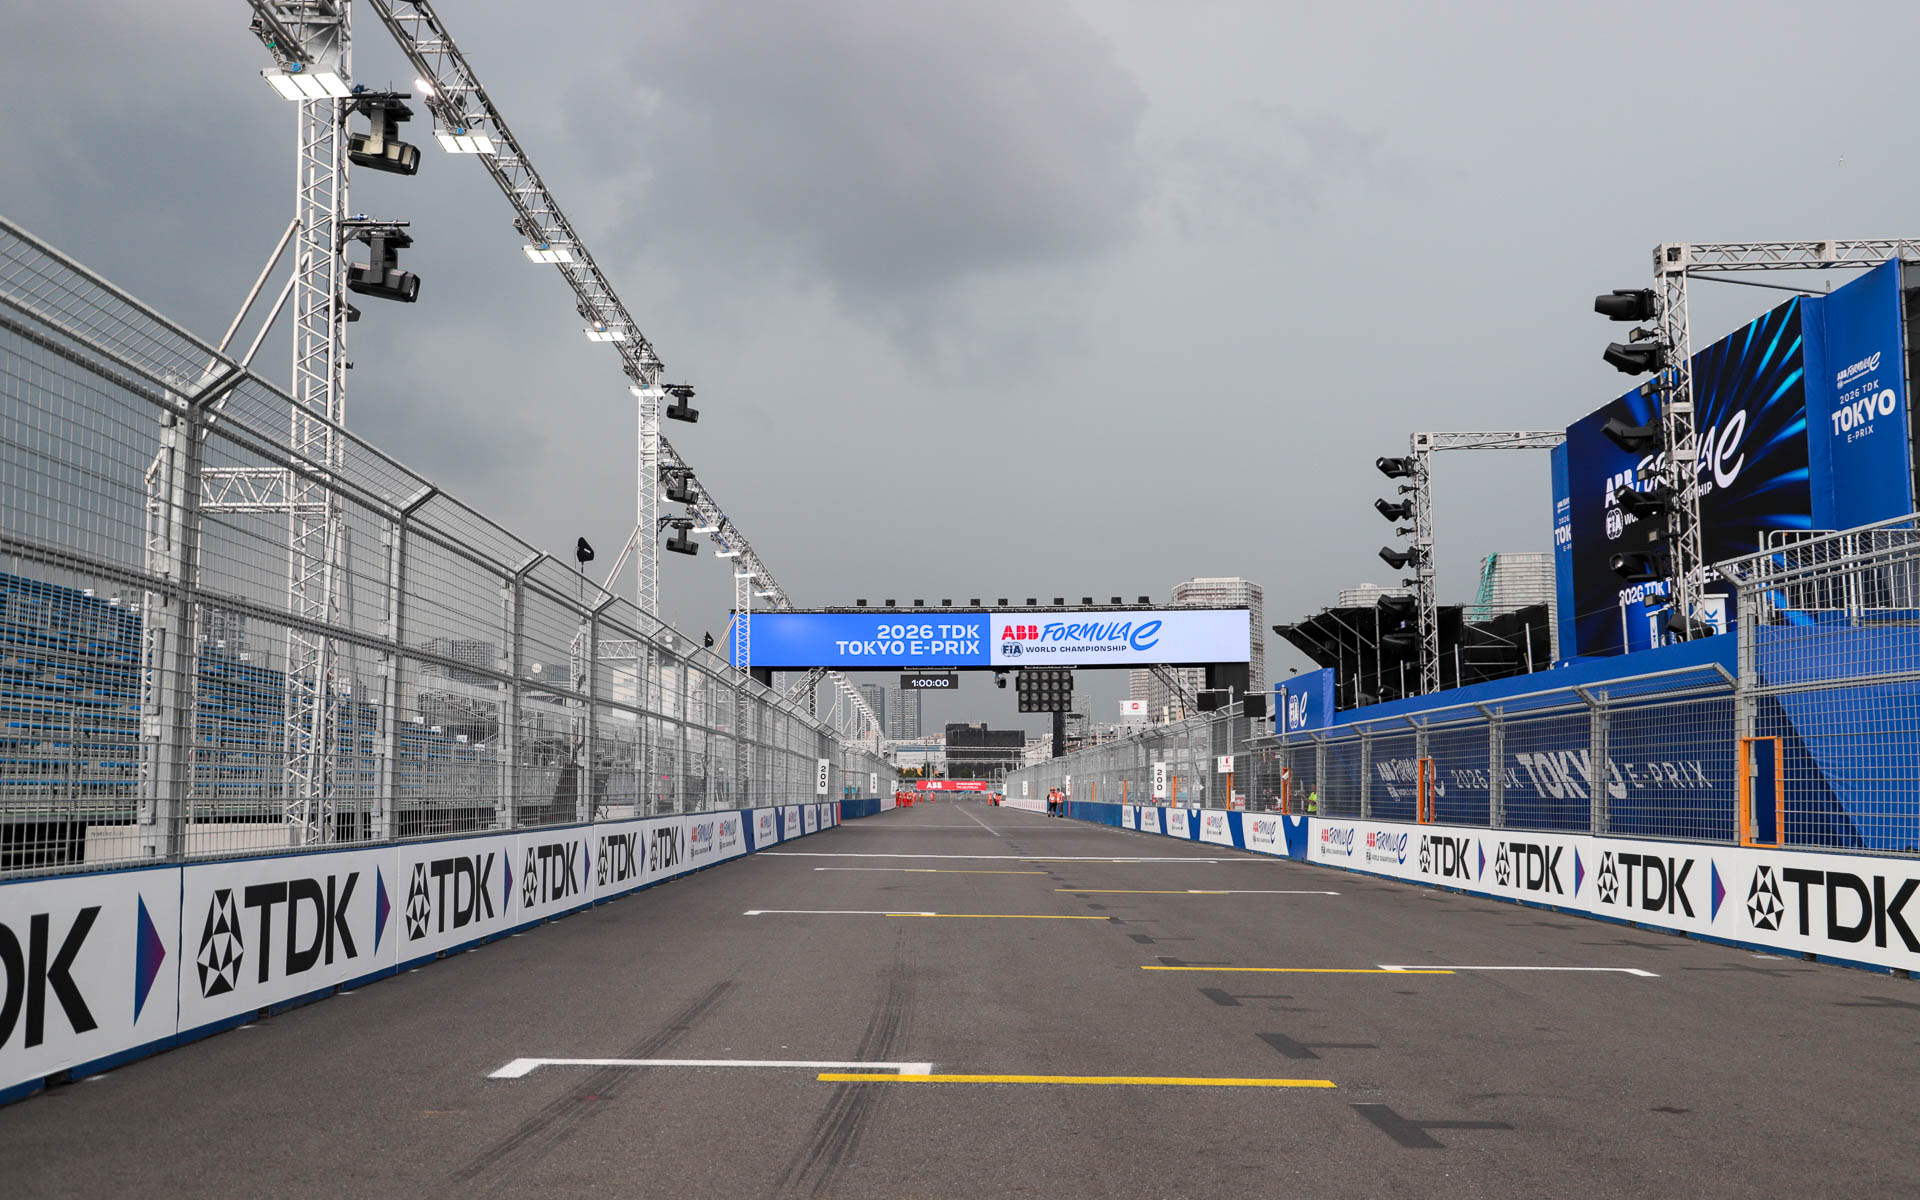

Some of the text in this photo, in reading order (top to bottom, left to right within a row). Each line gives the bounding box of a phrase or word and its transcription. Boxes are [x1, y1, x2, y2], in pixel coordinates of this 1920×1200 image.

[1832, 388, 1896, 436] TOKYO
[1840, 379, 1879, 404] 2026 TDK
[1847, 425, 1874, 443] E-PRIX
[836, 641, 980, 655] TOKYO E-PRIX
[876, 624, 980, 639] 2026 TDK
[1001, 625, 1039, 640] ABB
[1041, 622, 1133, 643] FORMULA
[1060, 645, 1127, 653] CHAMPIONSHIP
[911, 679, 950, 687] 1:00:00
[1451, 769, 1488, 789] 2026
[1626, 760, 1712, 789] E-PRIX
[608, 832, 637, 883] TDK
[657, 826, 679, 870] TDK
[1430, 836, 1470, 880] TDK
[1509, 843, 1564, 895] TDK
[431, 853, 495, 934] TDK
[538, 841, 578, 903] TDK
[1618, 853, 1696, 918] TDK
[244, 871, 360, 984] TDK
[1783, 868, 1920, 954] TDK
